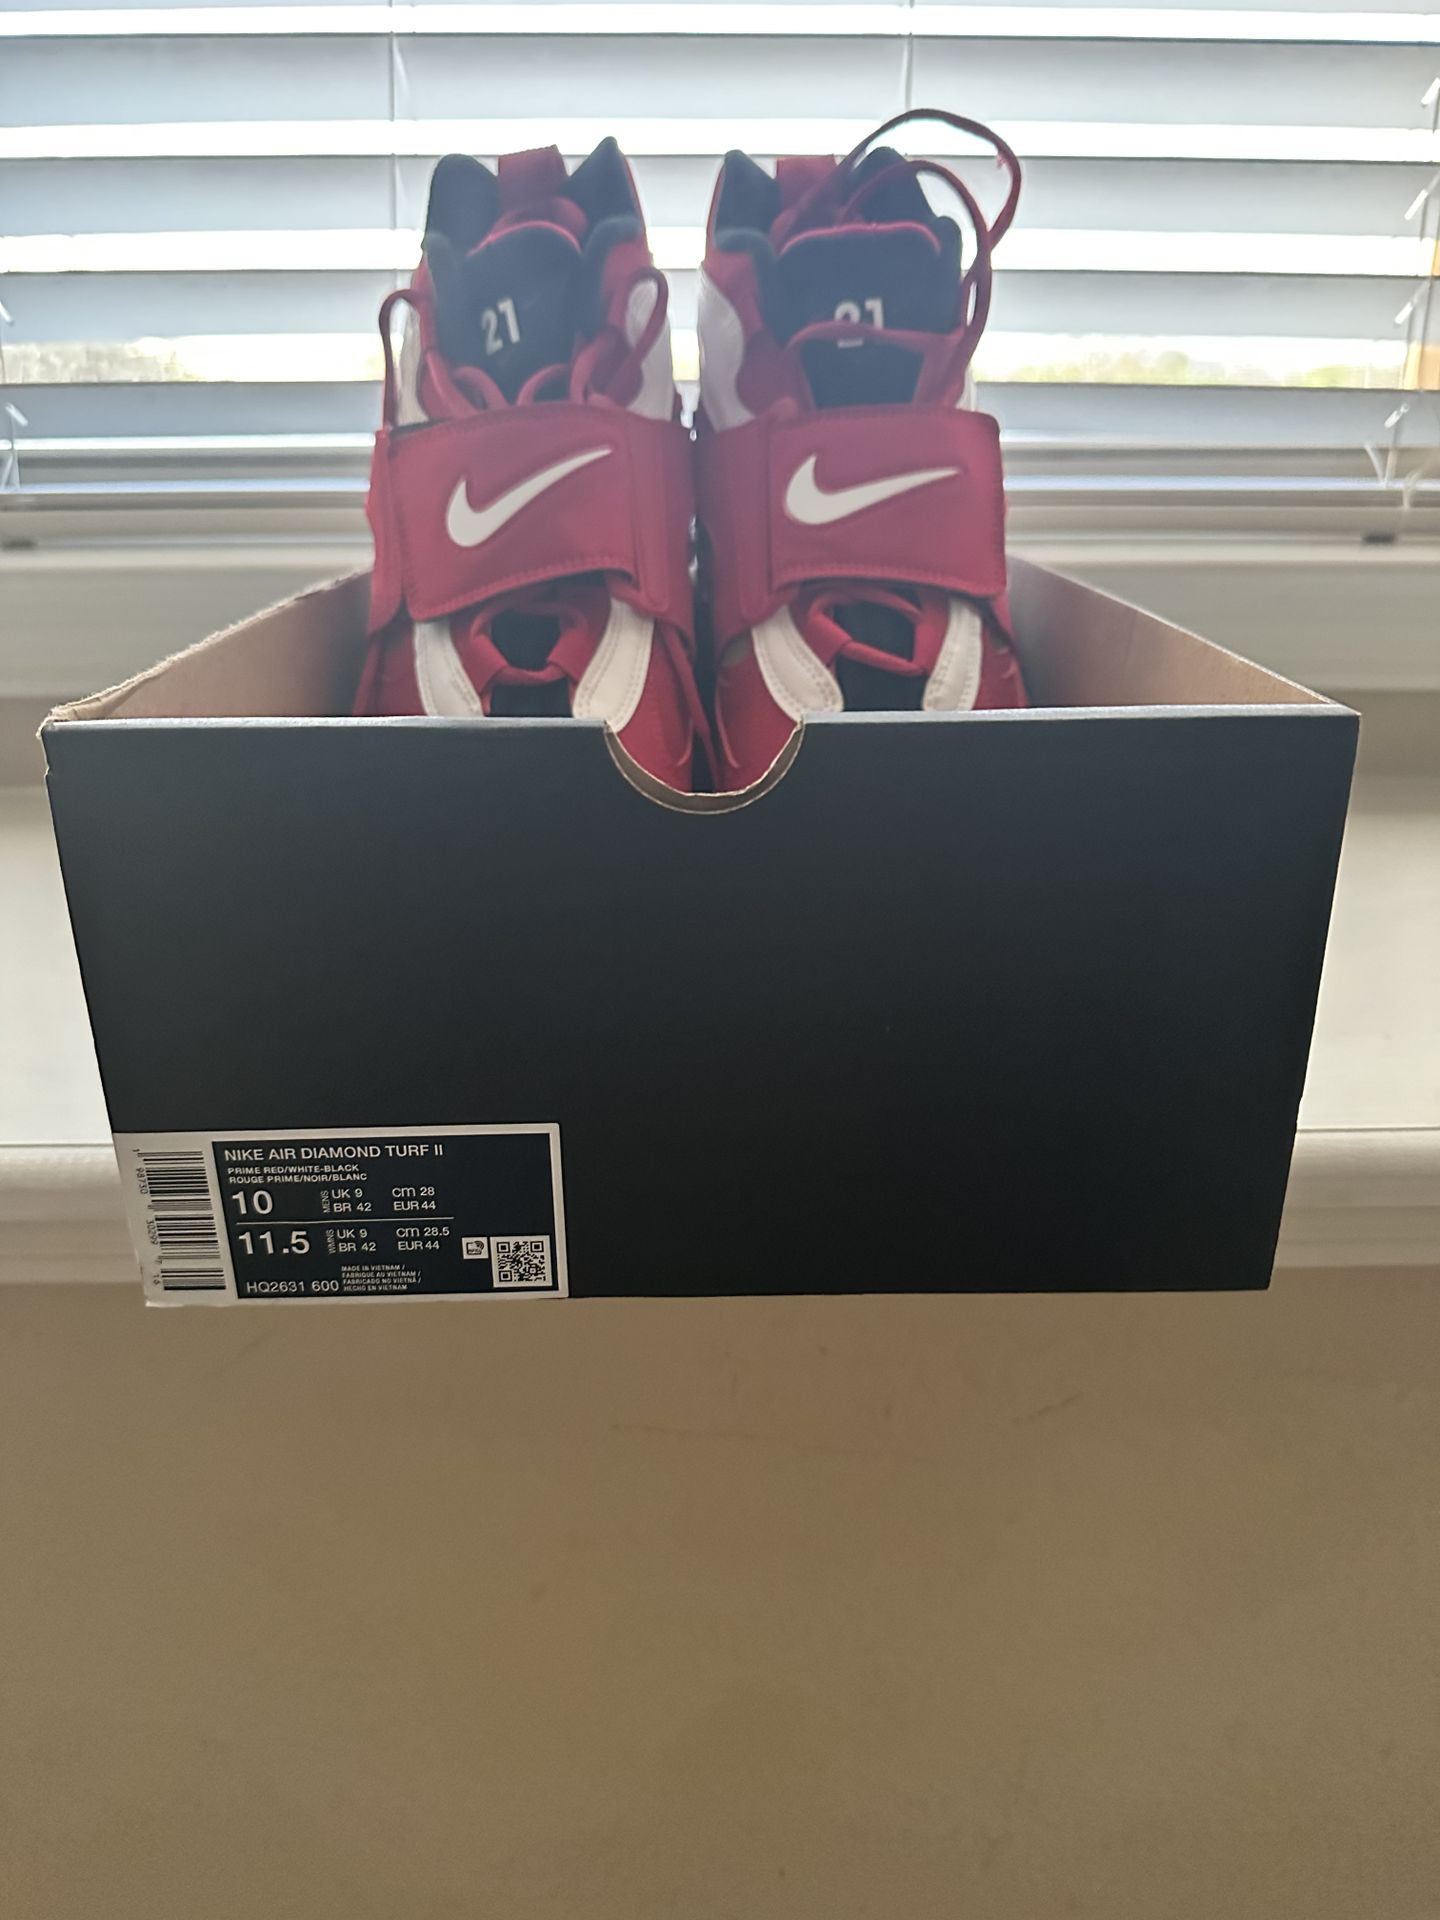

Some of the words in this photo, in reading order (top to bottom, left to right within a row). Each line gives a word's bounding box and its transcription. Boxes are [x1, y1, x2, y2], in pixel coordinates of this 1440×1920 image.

[481, 299, 520, 355] 21
[834, 299, 883, 348] 21
[224, 1149, 264, 1161] NIKE
[268, 1148, 296, 1160] AIR
[301, 1146, 381, 1159] DIAMOND
[385, 1144, 429, 1157] TURF
[434, 1144, 443, 1156] II
[263, 1164, 359, 1174] RED/WHITE-BLACK
[229, 1176, 264, 1184] ROUGE
[267, 1173, 368, 1183] PRIME/NOIR/BLANC
[331, 1188, 351, 1199] UK
[354, 1188, 363, 1198] 9
[392, 1187, 416, 1198] cm
[420, 1186, 435, 1196] 28
[232, 1190, 273, 1215] 10
[320, 1190, 331, 1213] MENS
[333, 1203, 352, 1213] BR
[356, 1202, 372, 1212] 42
[393, 1201, 420, 1211] EUR
[421, 1201, 436, 1210] 44
[337, 1229, 356, 1239] UK
[359, 1229, 368, 1238] 9
[396, 1227, 420, 1238] cm
[423, 1226, 450, 1237] 28.5
[238, 1230, 310, 1255] 11.5
[325, 1229, 337, 1254] WMNS
[338, 1242, 357, 1252] BR
[361, 1242, 377, 1252] 42
[397, 1241, 423, 1251] EUR
[425, 1240, 440, 1250] 44
[246, 1281, 305, 1293] HQ2631
[311, 1280, 339, 1292] 600
